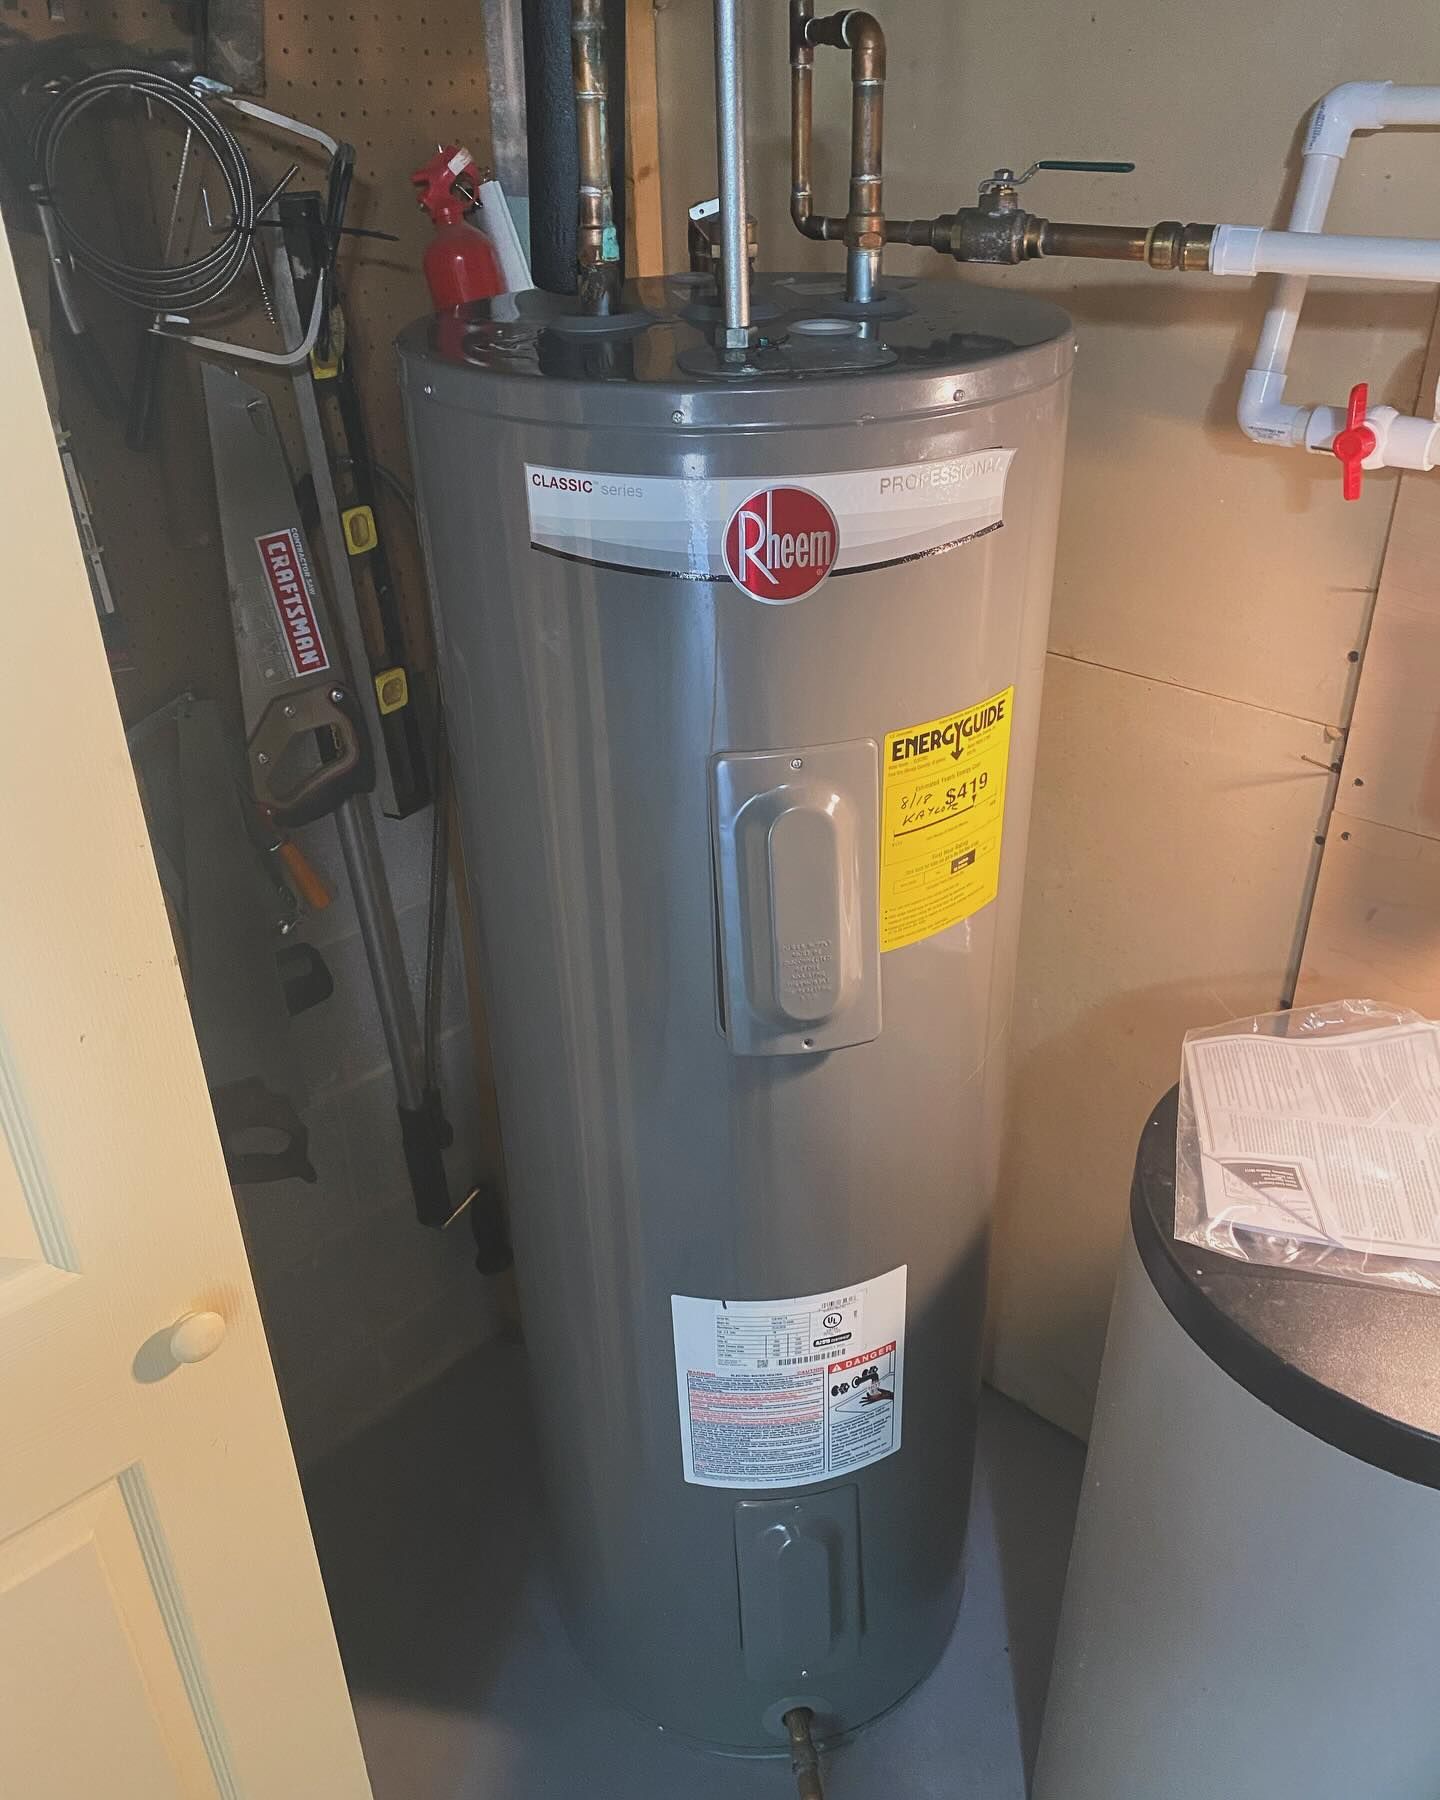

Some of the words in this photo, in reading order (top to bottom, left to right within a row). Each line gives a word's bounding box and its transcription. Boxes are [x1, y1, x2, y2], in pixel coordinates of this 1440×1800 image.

[532, 473, 593, 493] CLASSIC
[601, 483, 644, 498] series
[291, 527, 310, 578] CONTRACTOR
[738, 490, 831, 585] Rheem
[267, 541, 320, 666] CRAFTSMAN
[892, 699, 1006, 762] ENERGYGUIDE
[945, 771, 988, 806] $419
[845, 1344, 892, 1368] DANGER
